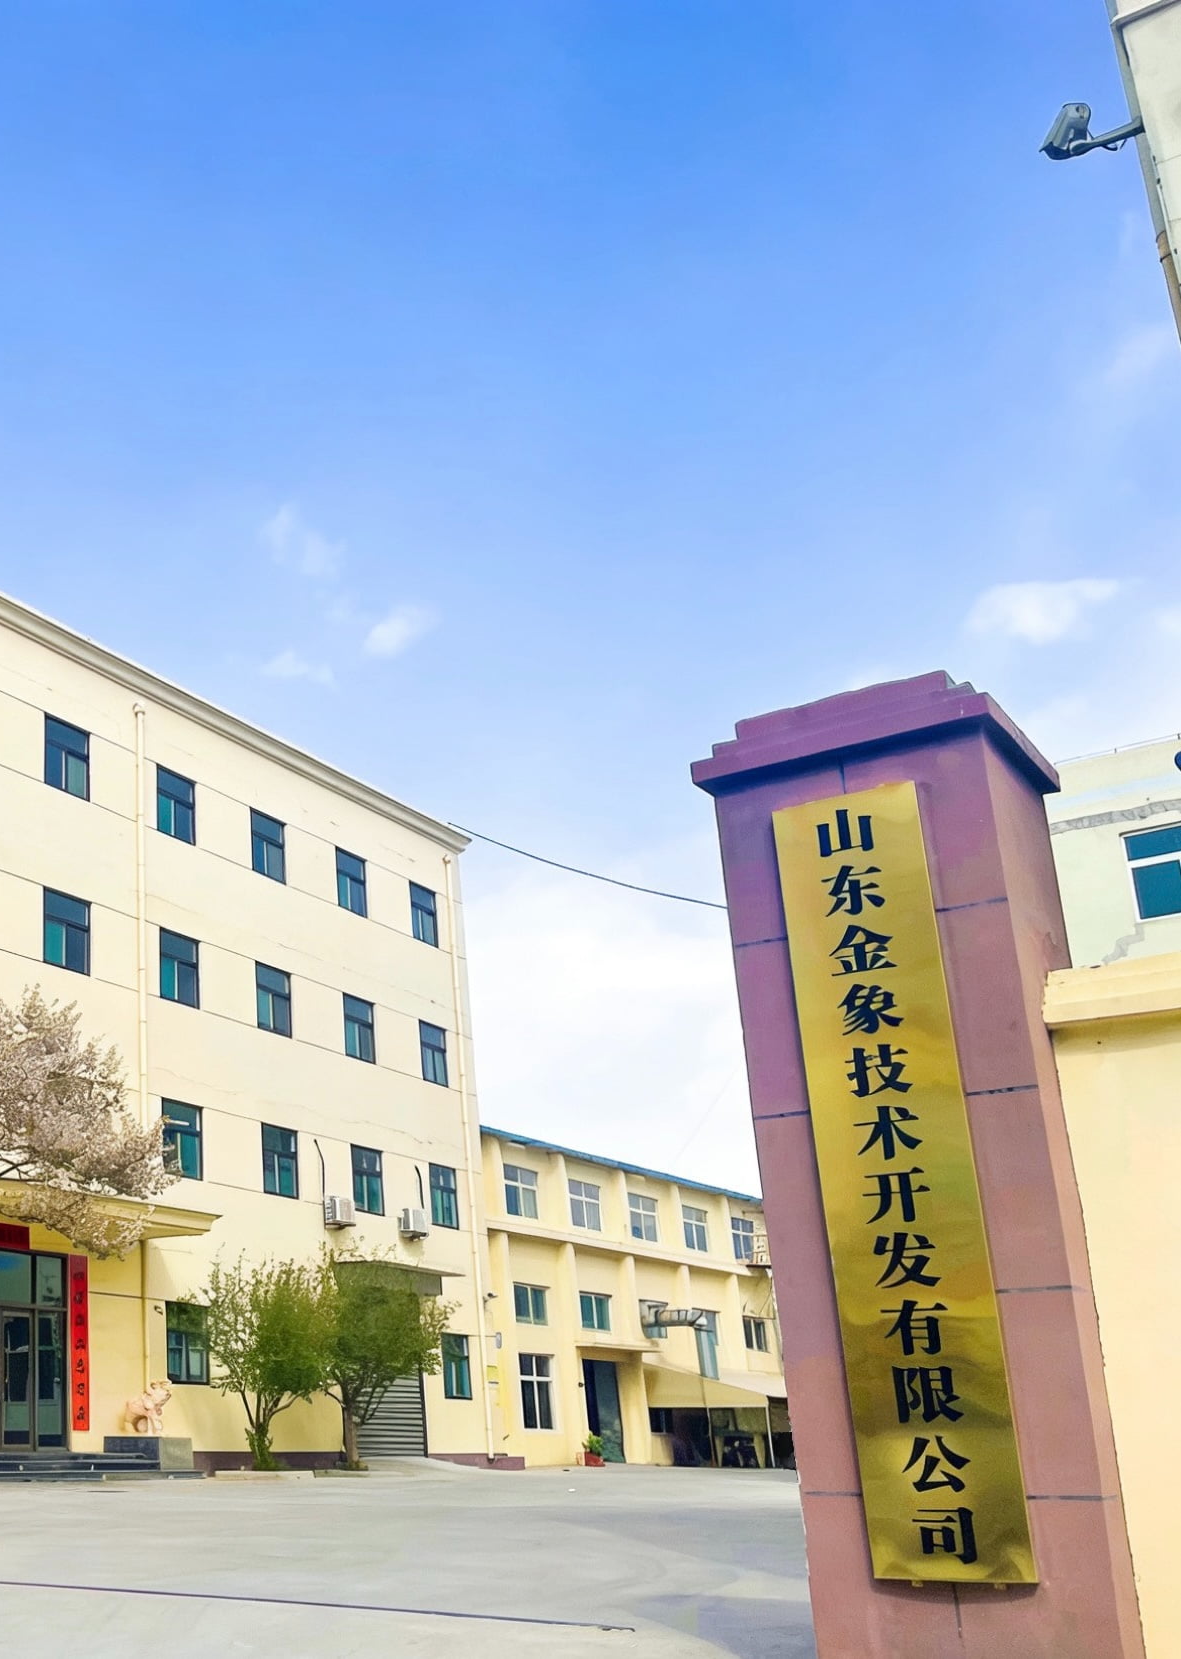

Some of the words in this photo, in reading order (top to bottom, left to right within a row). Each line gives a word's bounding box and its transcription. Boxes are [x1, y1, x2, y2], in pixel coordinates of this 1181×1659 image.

[816, 809, 977, 1565] 山东金象技术开发有限公司
